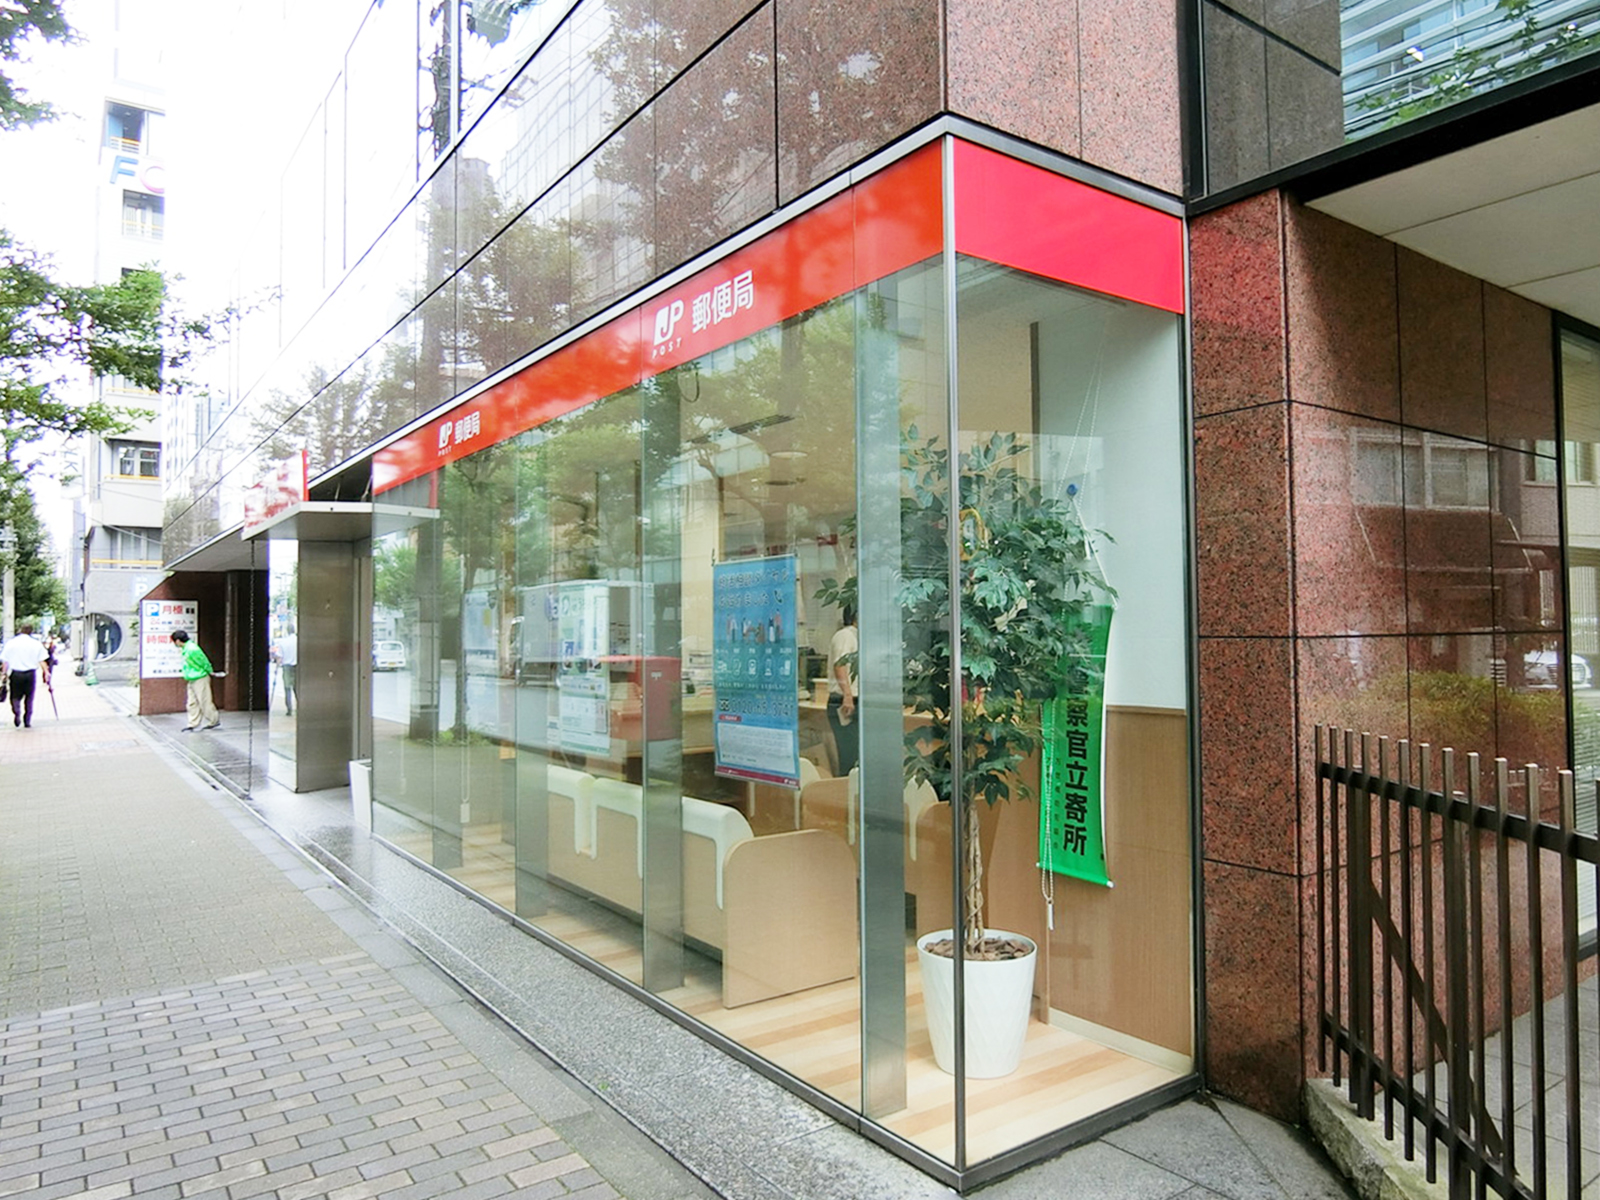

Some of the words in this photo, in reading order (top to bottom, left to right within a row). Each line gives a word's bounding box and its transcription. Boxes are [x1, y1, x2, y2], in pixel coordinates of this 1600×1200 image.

[691, 269, 754, 334] 郵便局
[651, 337, 682, 359] POST
[454, 411, 480, 445] 郵便局
[437, 445, 452, 457] POST
[135, 582, 148, 597] P
[146, 635, 173, 644] 時間
